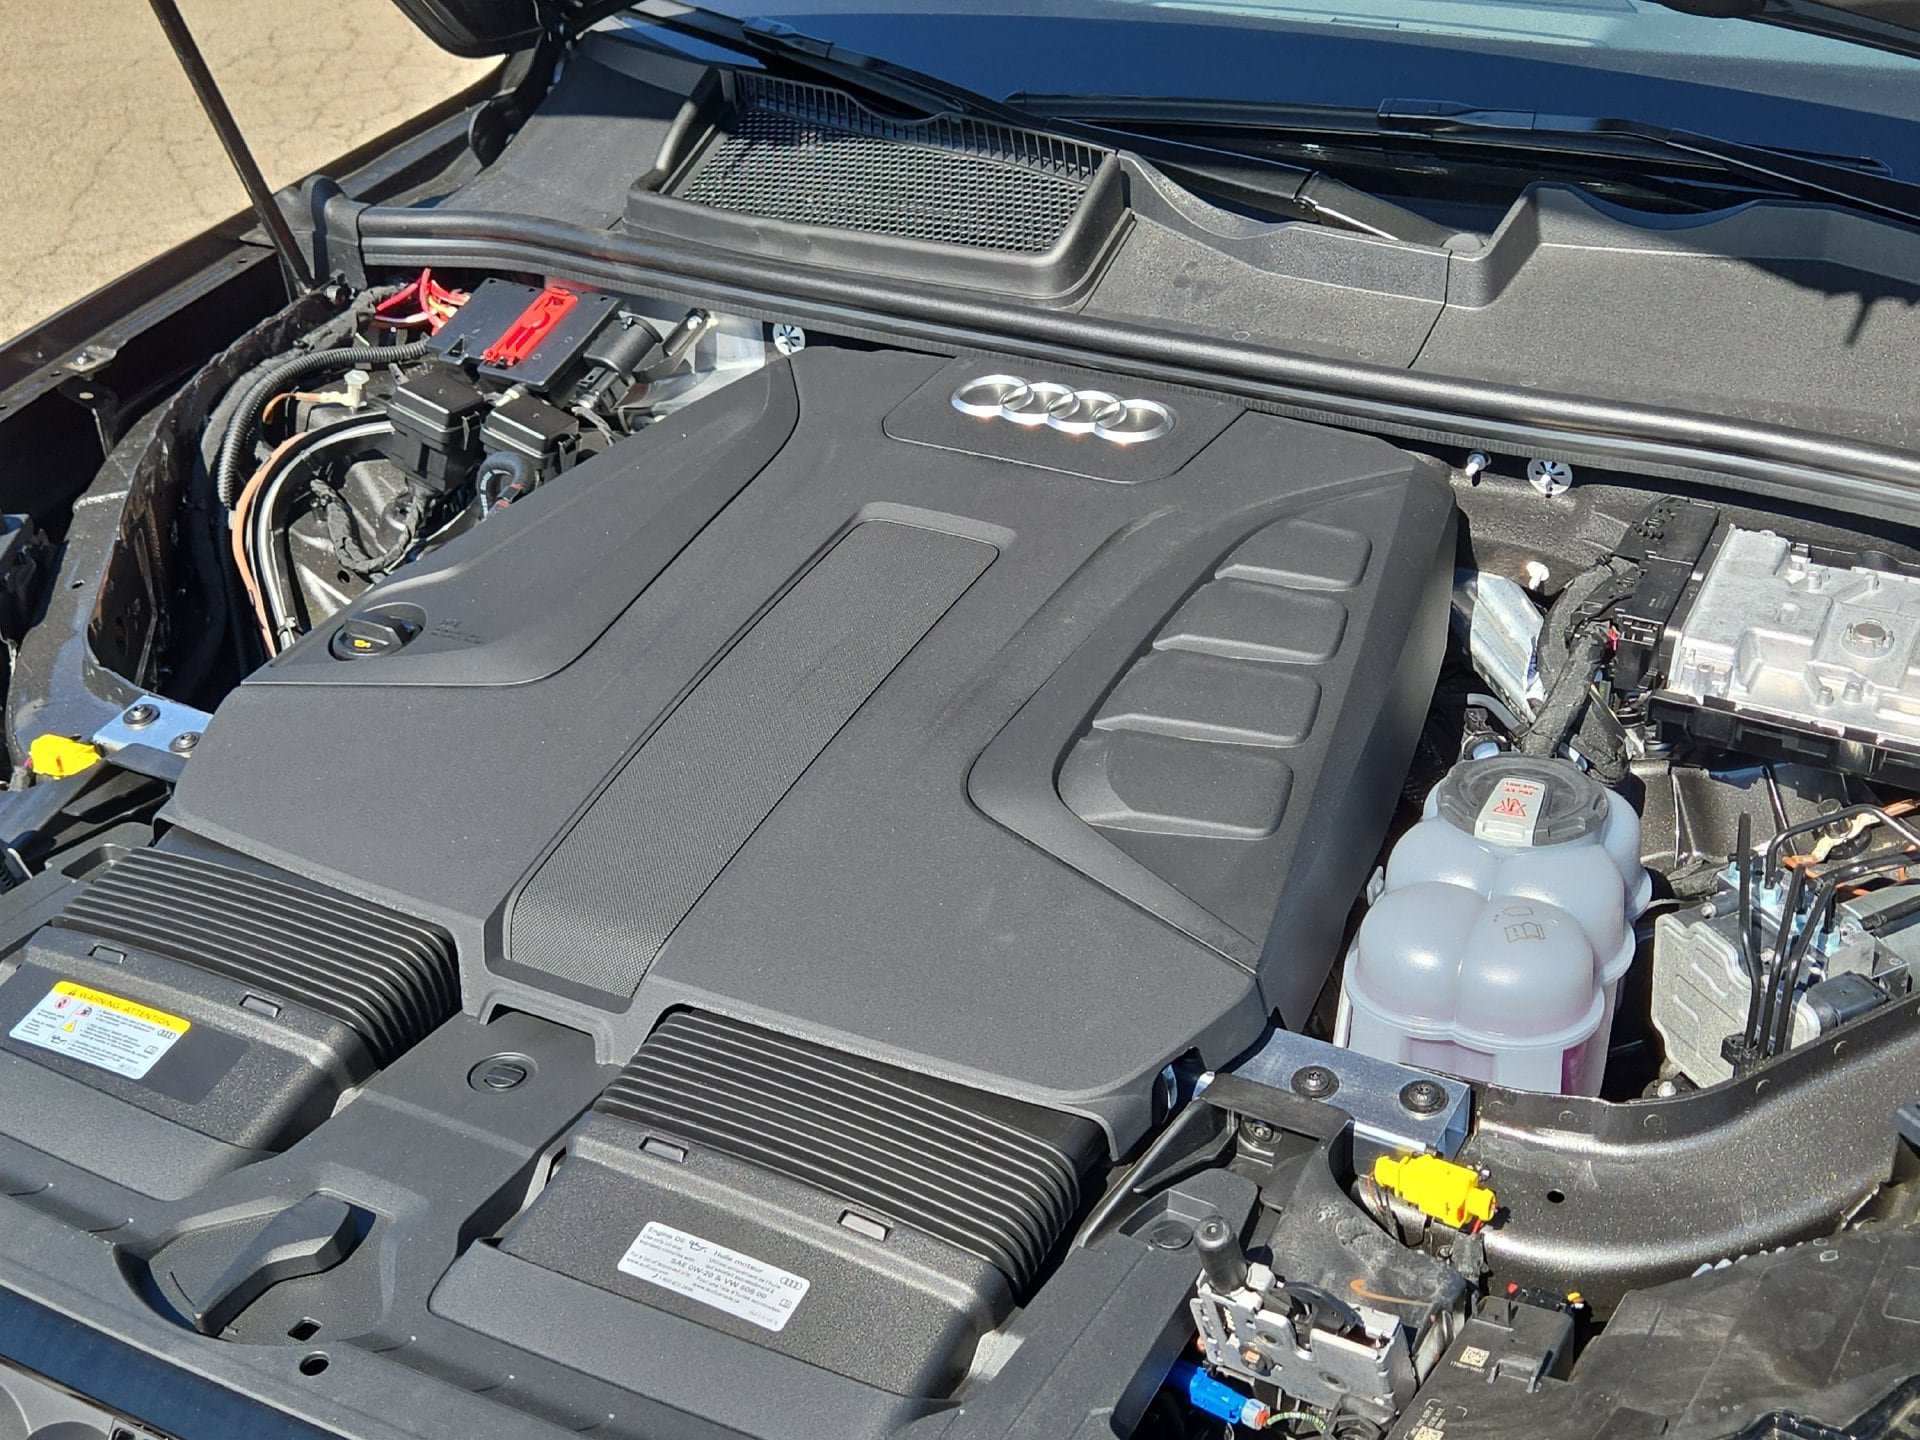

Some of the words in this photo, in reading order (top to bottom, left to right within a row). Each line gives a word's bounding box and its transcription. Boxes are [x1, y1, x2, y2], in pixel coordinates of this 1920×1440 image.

[79, 992, 120, 1008] WARNING
[123, 1007, 172, 1025] ATTENTION
[647, 1226, 673, 1239] Engine
[674, 1235, 685, 1243] Oil
[670, 1258, 687, 1267] SAE
[687, 1264, 714, 1277] 0W-20
[723, 1278, 739, 1287] VW
[733, 1259, 763, 1273] moteur
